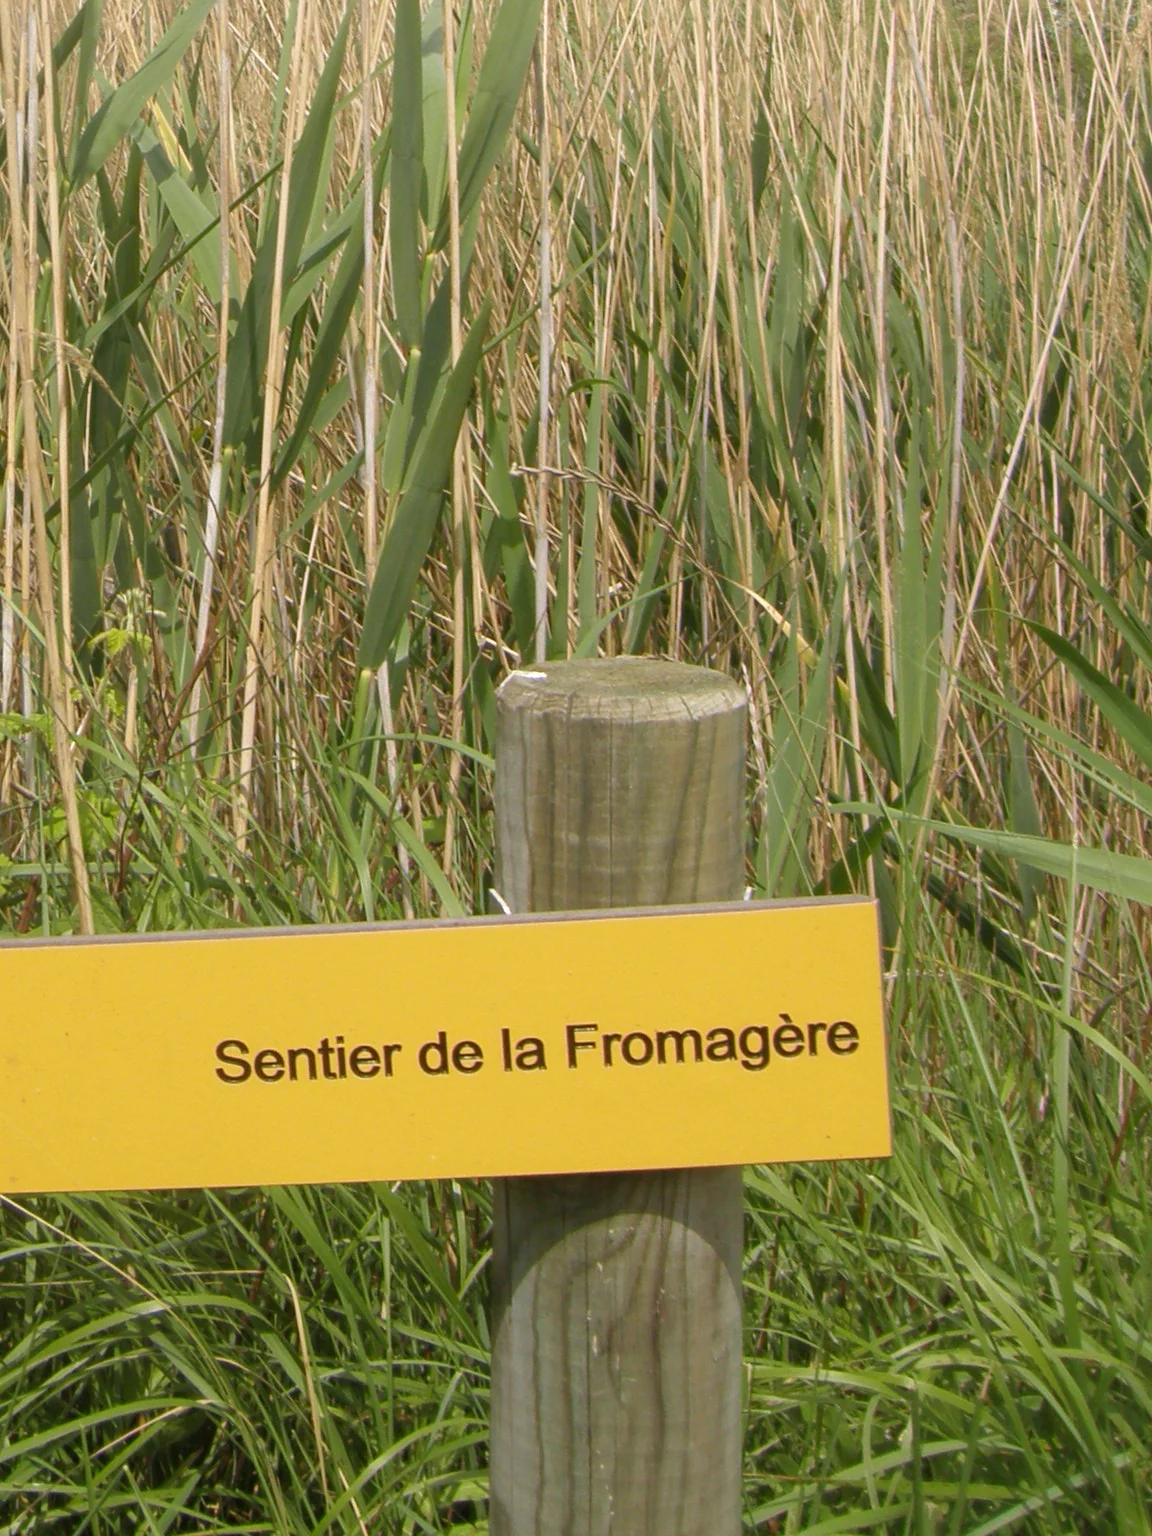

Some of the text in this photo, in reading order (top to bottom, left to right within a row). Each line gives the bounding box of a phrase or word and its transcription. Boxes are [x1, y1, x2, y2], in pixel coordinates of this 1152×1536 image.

[215, 1013, 859, 1084] Sentier de la Fromagère
